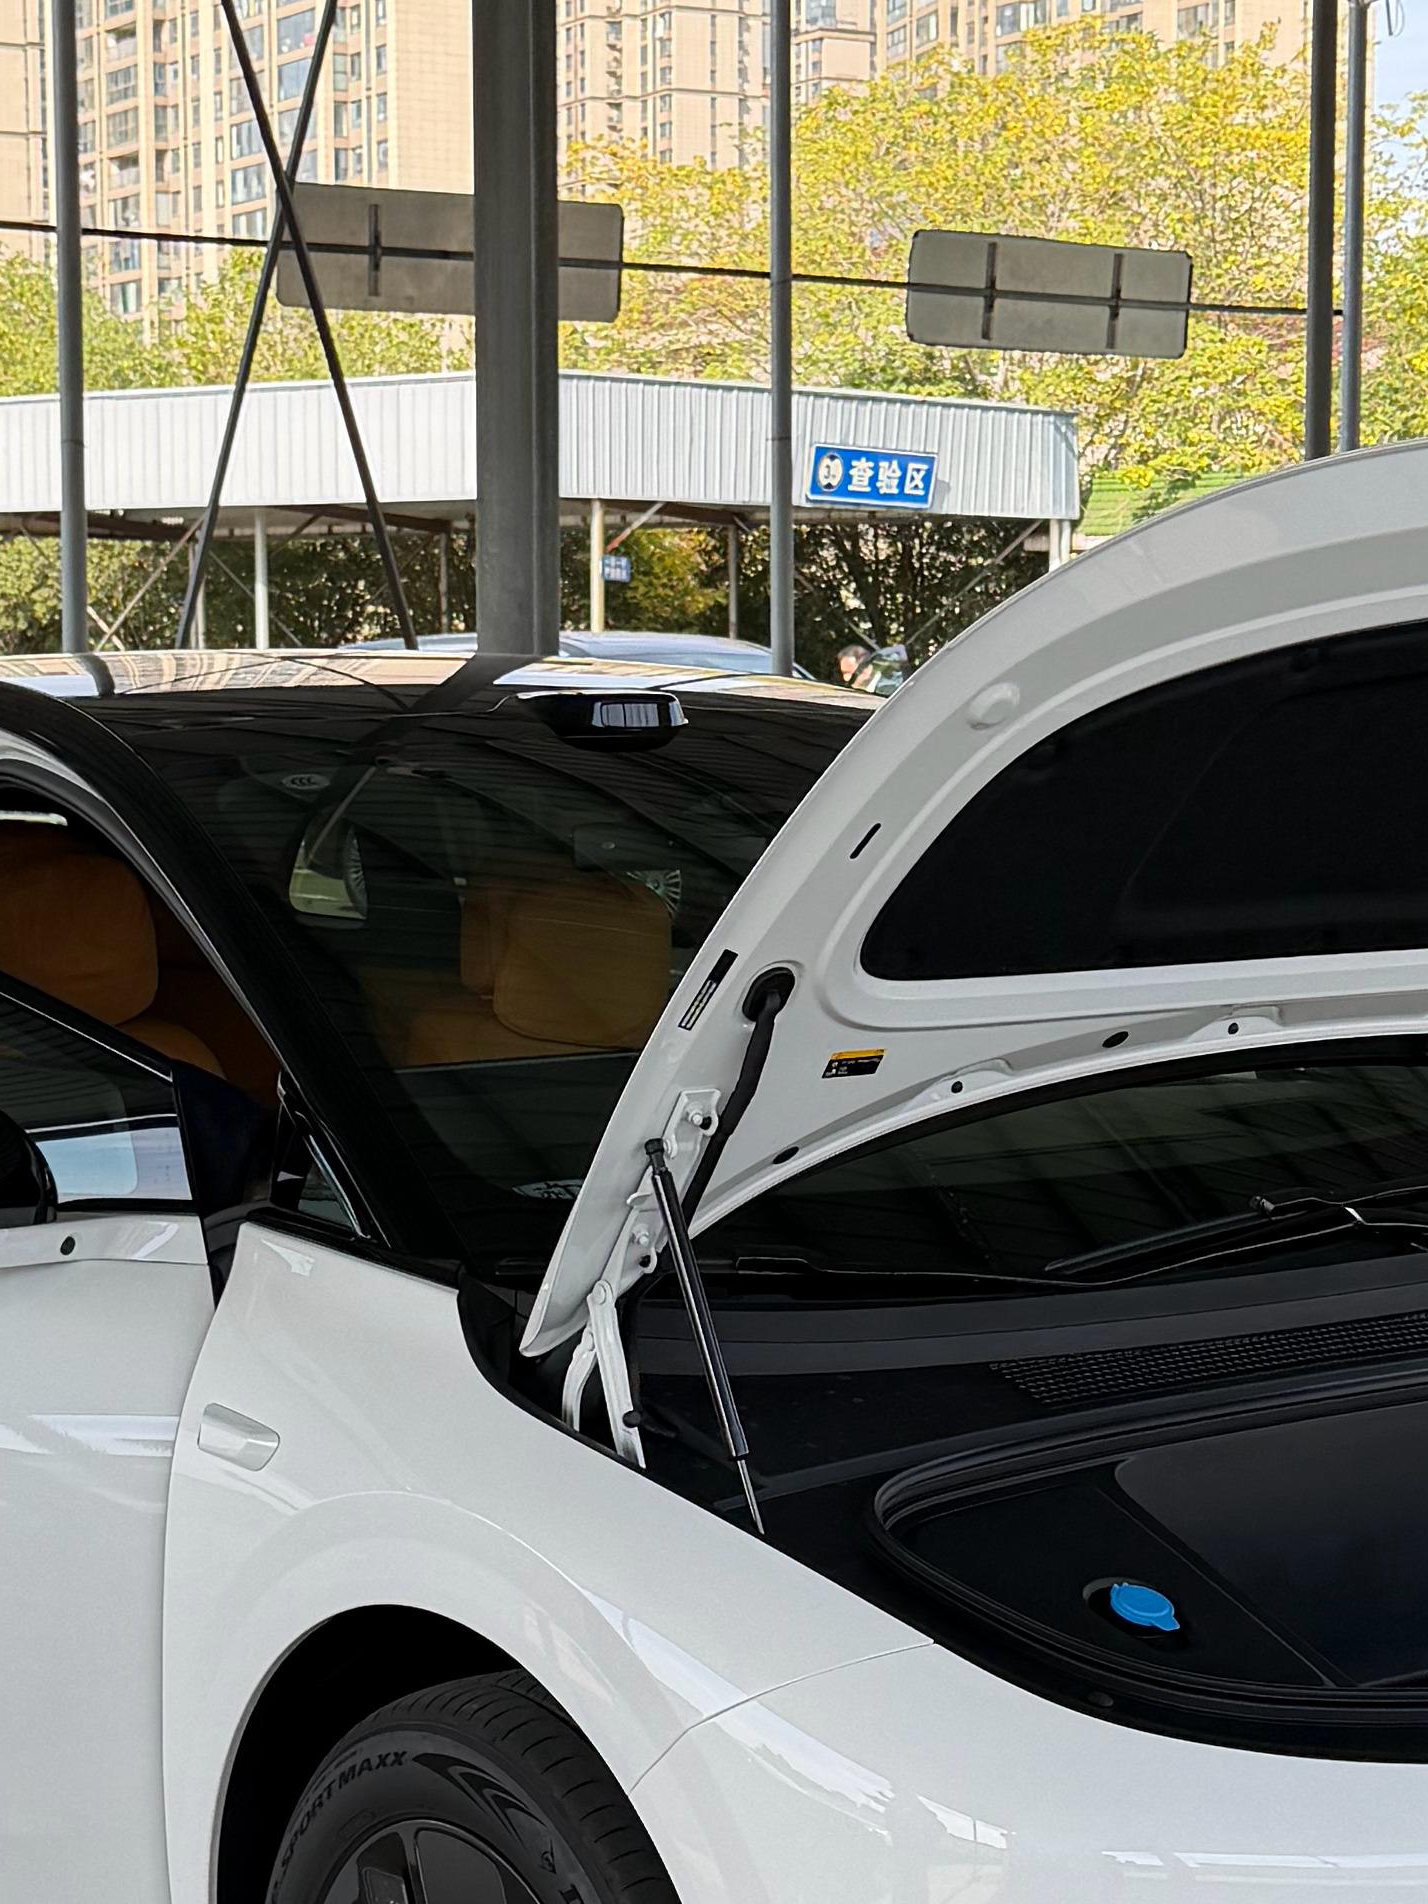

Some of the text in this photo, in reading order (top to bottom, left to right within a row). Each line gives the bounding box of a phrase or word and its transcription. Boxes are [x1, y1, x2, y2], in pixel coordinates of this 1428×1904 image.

[847, 457, 929, 496] 查验区
[337, 1751, 409, 1790] MAXX
